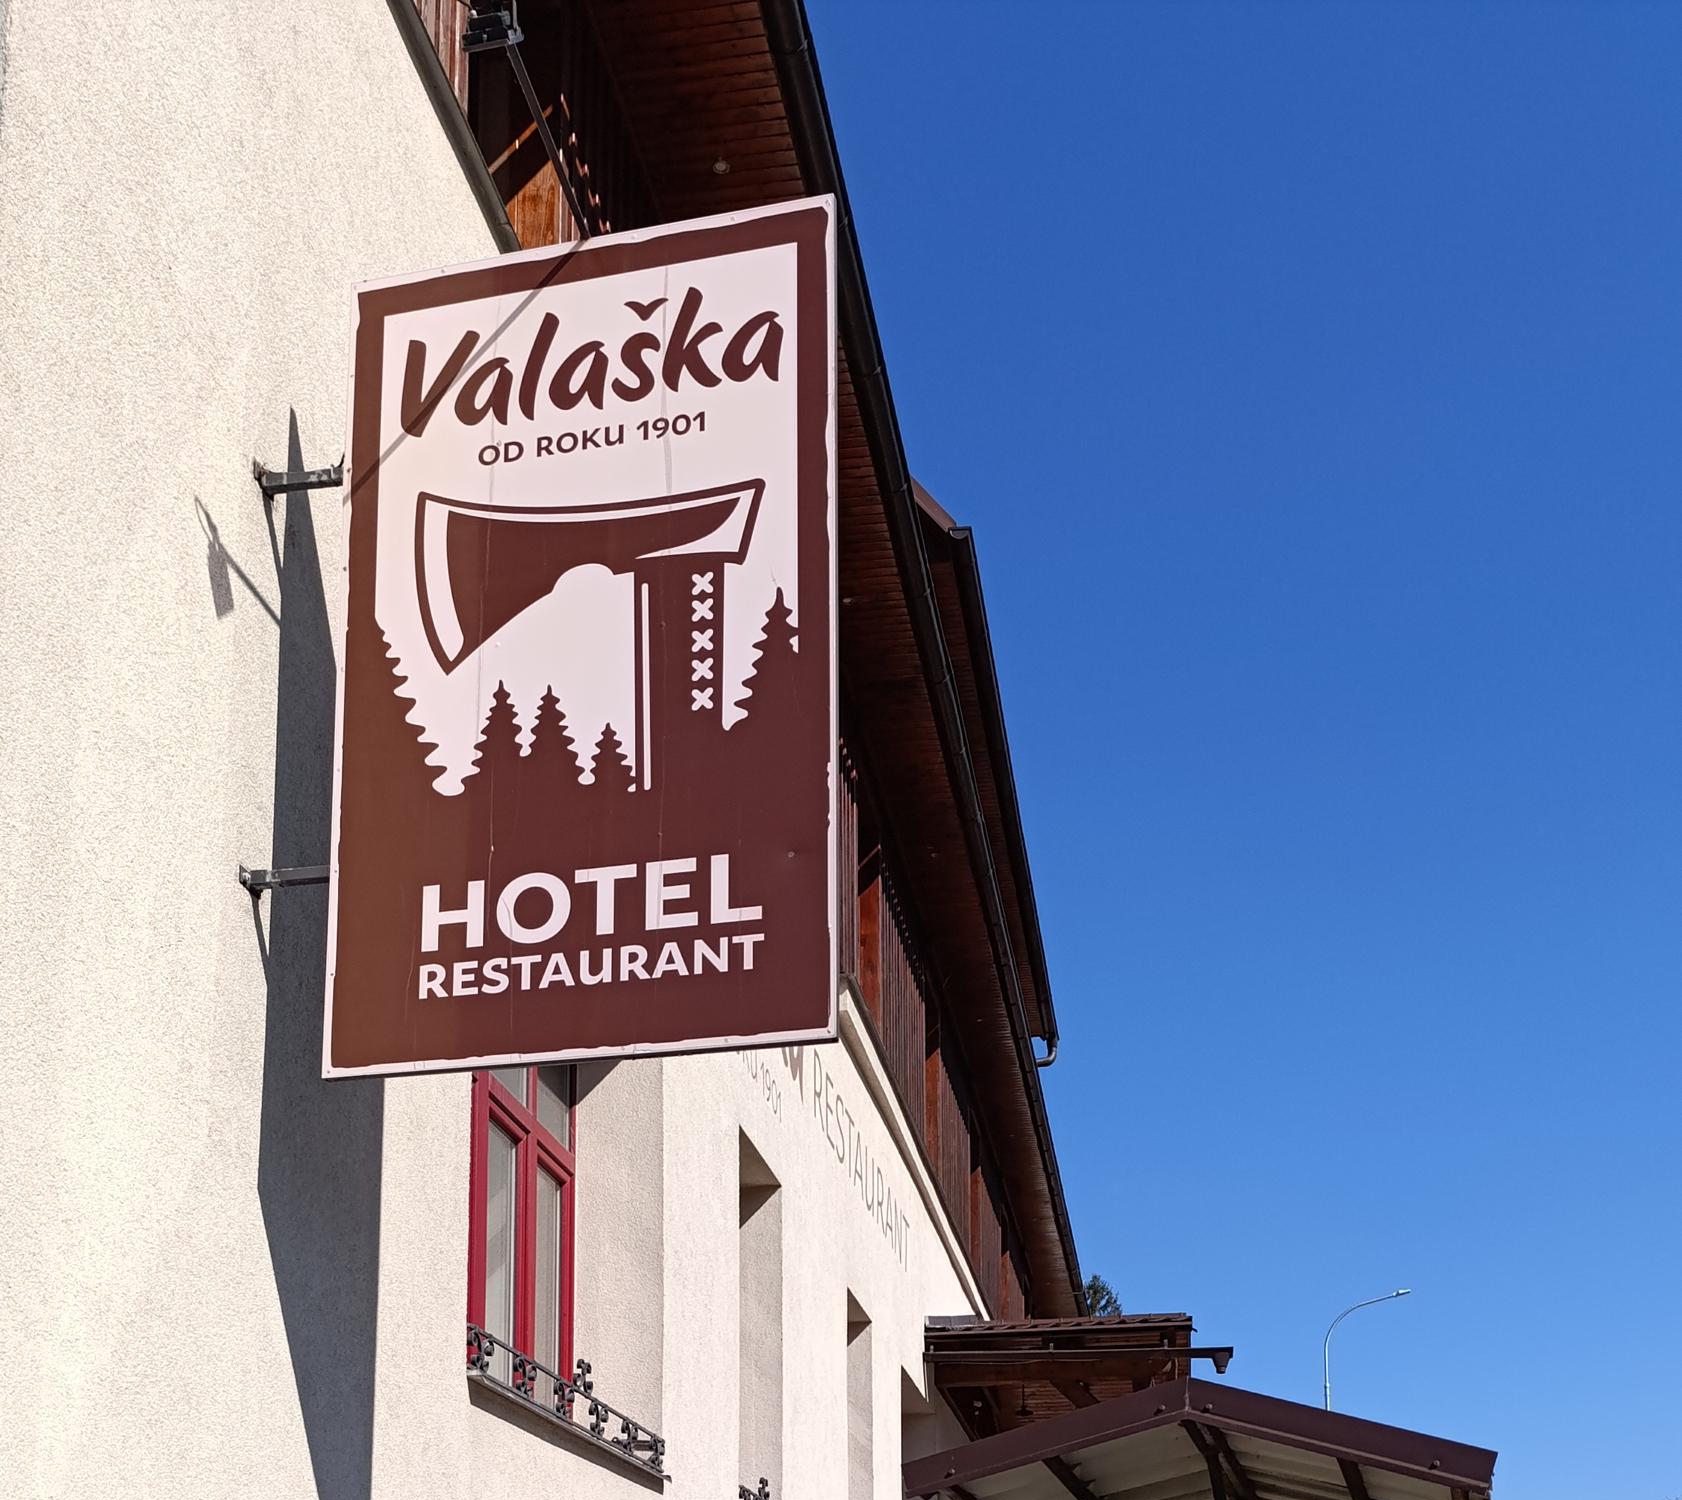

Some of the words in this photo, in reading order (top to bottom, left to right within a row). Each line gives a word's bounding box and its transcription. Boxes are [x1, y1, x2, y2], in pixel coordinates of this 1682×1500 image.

[400, 286, 784, 438] Valaška
[477, 440, 525, 466] OD
[535, 424, 626, 458] ROKU
[636, 410, 708, 441] 1901
[419, 853, 763, 953] HOTEL
[417, 932, 766, 1000] RESTAURANT
[760, 1061, 782, 1124] 1901
[813, 1047, 910, 1273] RESTAURANT
